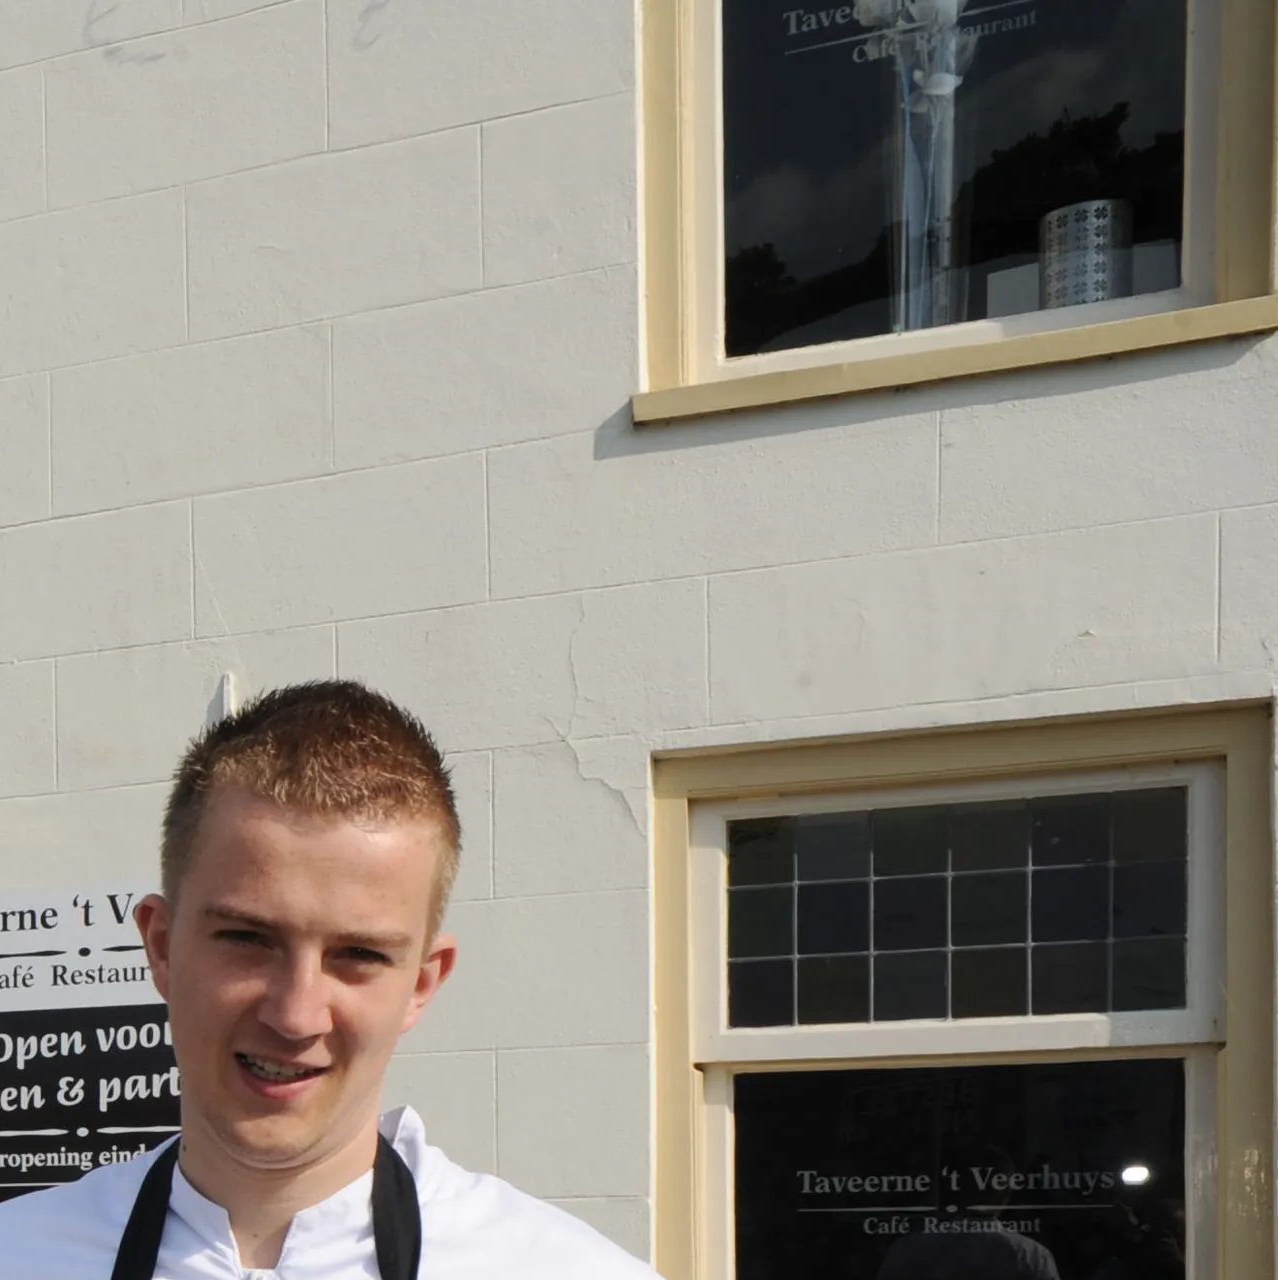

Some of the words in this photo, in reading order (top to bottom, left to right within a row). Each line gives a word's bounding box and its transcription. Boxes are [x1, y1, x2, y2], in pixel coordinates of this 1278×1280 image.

[56, 1076, 85, 1106] &
[796, 1170, 931, 1193] Taveerne
[969, 1164, 1115, 1195] Veerhuys
[863, 1216, 910, 1234] Café
[923, 1216, 1041, 1233] Restaurant
